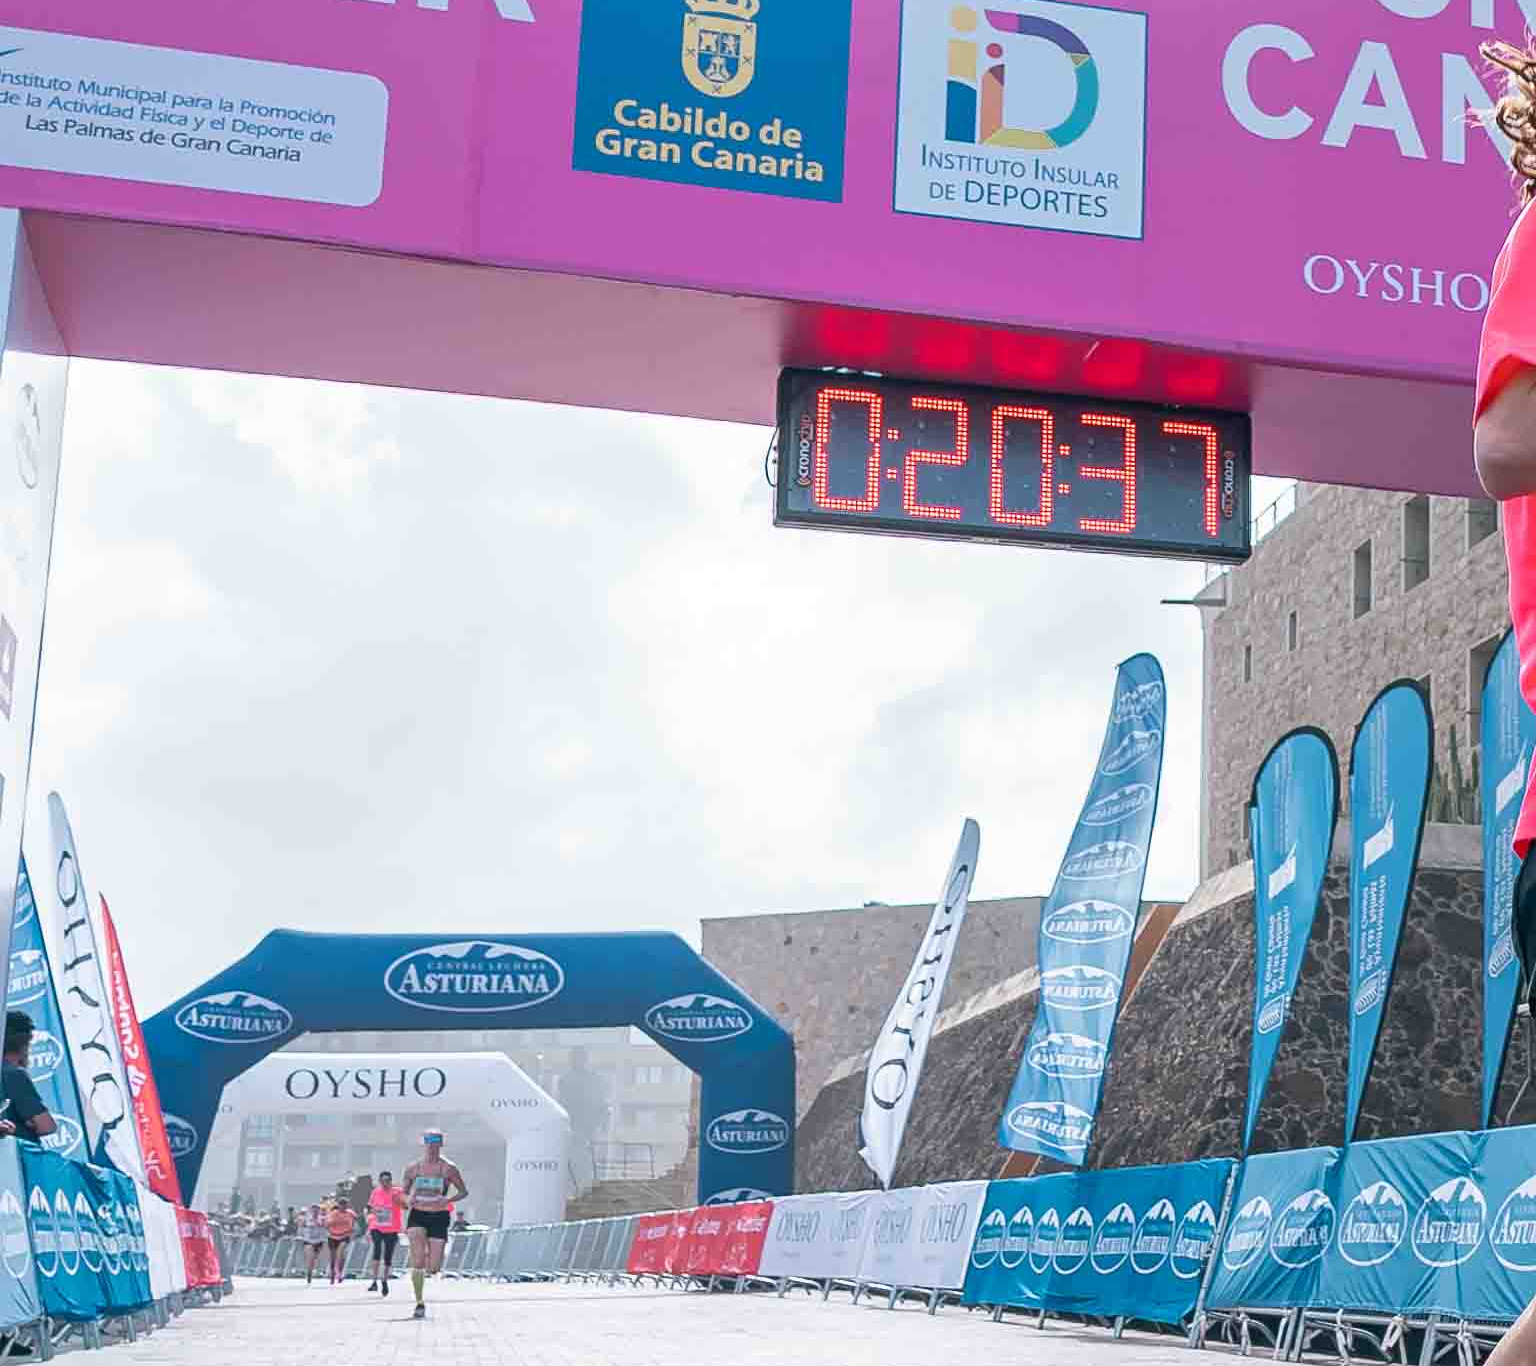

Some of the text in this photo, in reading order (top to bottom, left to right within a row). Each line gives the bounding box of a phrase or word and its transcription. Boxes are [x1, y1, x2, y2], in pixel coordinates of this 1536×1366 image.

[26, 92, 41, 108] la
[48, 96, 133, 120] Actividad
[193, 116, 204, 131] y
[210, 114, 225, 131] el
[231, 118, 304, 143] Deporte
[310, 128, 333, 144] de
[77, 78, 166, 109] Municipal
[171, 92, 212, 114] para
[219, 96, 234, 113] la
[240, 99, 336, 126] Promoción
[613, 98, 802, 149] Cabildo de
[25, 114, 301, 162] Las Palmas de Gran Canaria
[595, 129, 824, 183] Gran Canaria
[921, 143, 1119, 189] INSTITUTO INSULAR
[929, 179, 1109, 218] DE DEPORTES
[1304, 254, 1489, 313] OYSHO
[814, 388, 1217, 536] 0:20:37
[398, 963, 550, 994] ASTURIANA
[184, 1007, 283, 1033] ASTURIANA
[653, 1012, 744, 1030] ASTURIANA
[285, 1066, 447, 1099] OYSHO
